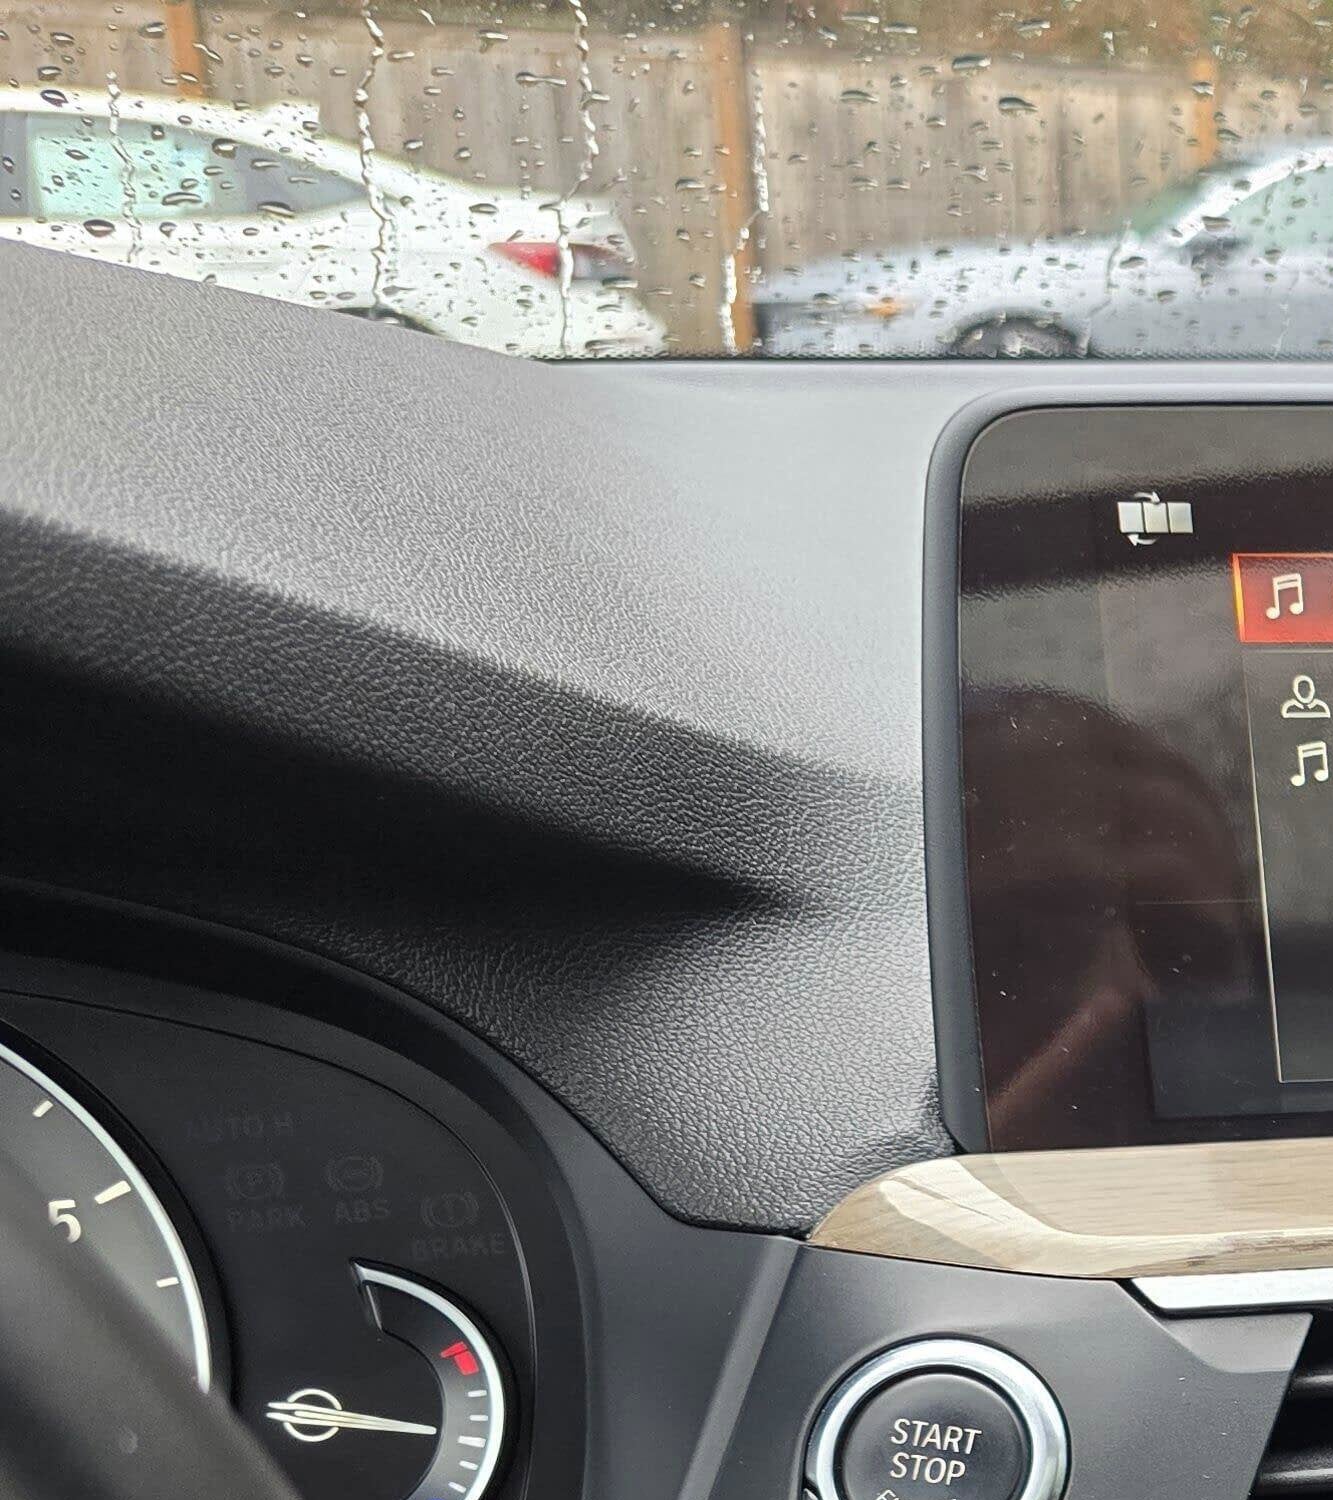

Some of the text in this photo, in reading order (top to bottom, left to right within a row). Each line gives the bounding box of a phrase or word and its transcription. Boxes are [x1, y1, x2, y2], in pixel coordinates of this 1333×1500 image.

[48, 1199, 82, 1244] 5
[890, 1417, 982, 1455] START
[889, 1452, 966, 1486] STOP
